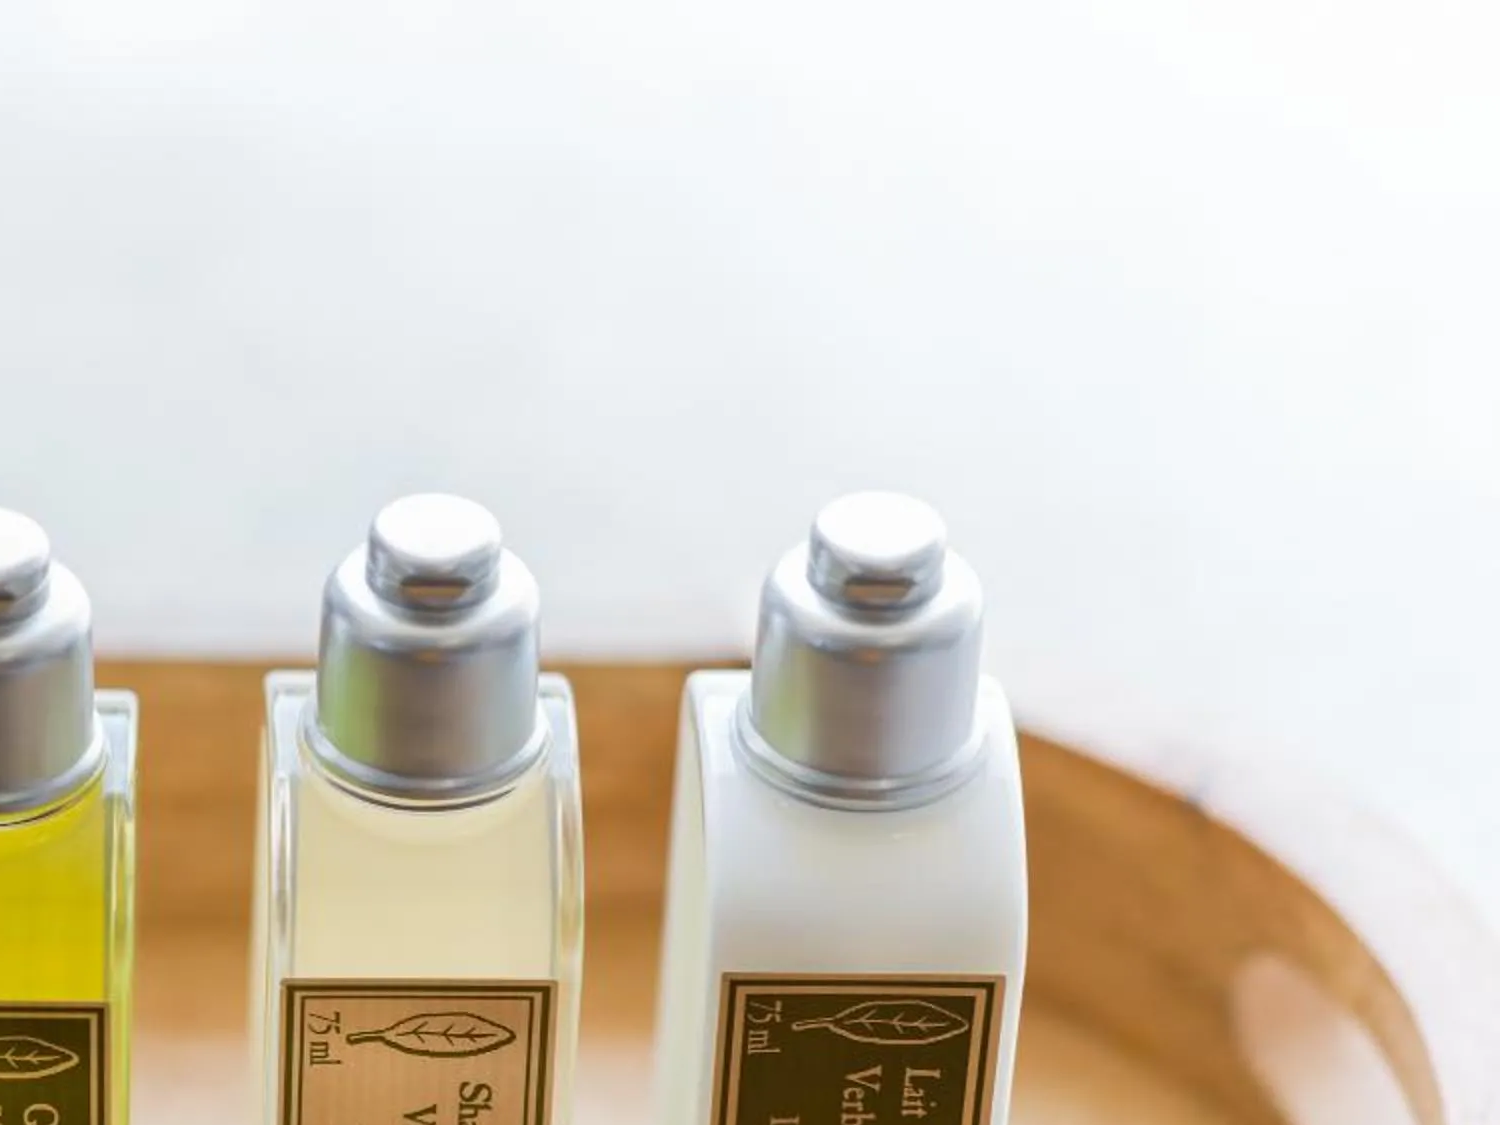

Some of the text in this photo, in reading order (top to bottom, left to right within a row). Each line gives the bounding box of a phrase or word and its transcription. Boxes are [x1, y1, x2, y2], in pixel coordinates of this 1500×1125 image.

[308, 1011, 341, 1066] 75 ml
[747, 1000, 781, 1054] 75 ml
[901, 1067, 940, 1117] Lait
